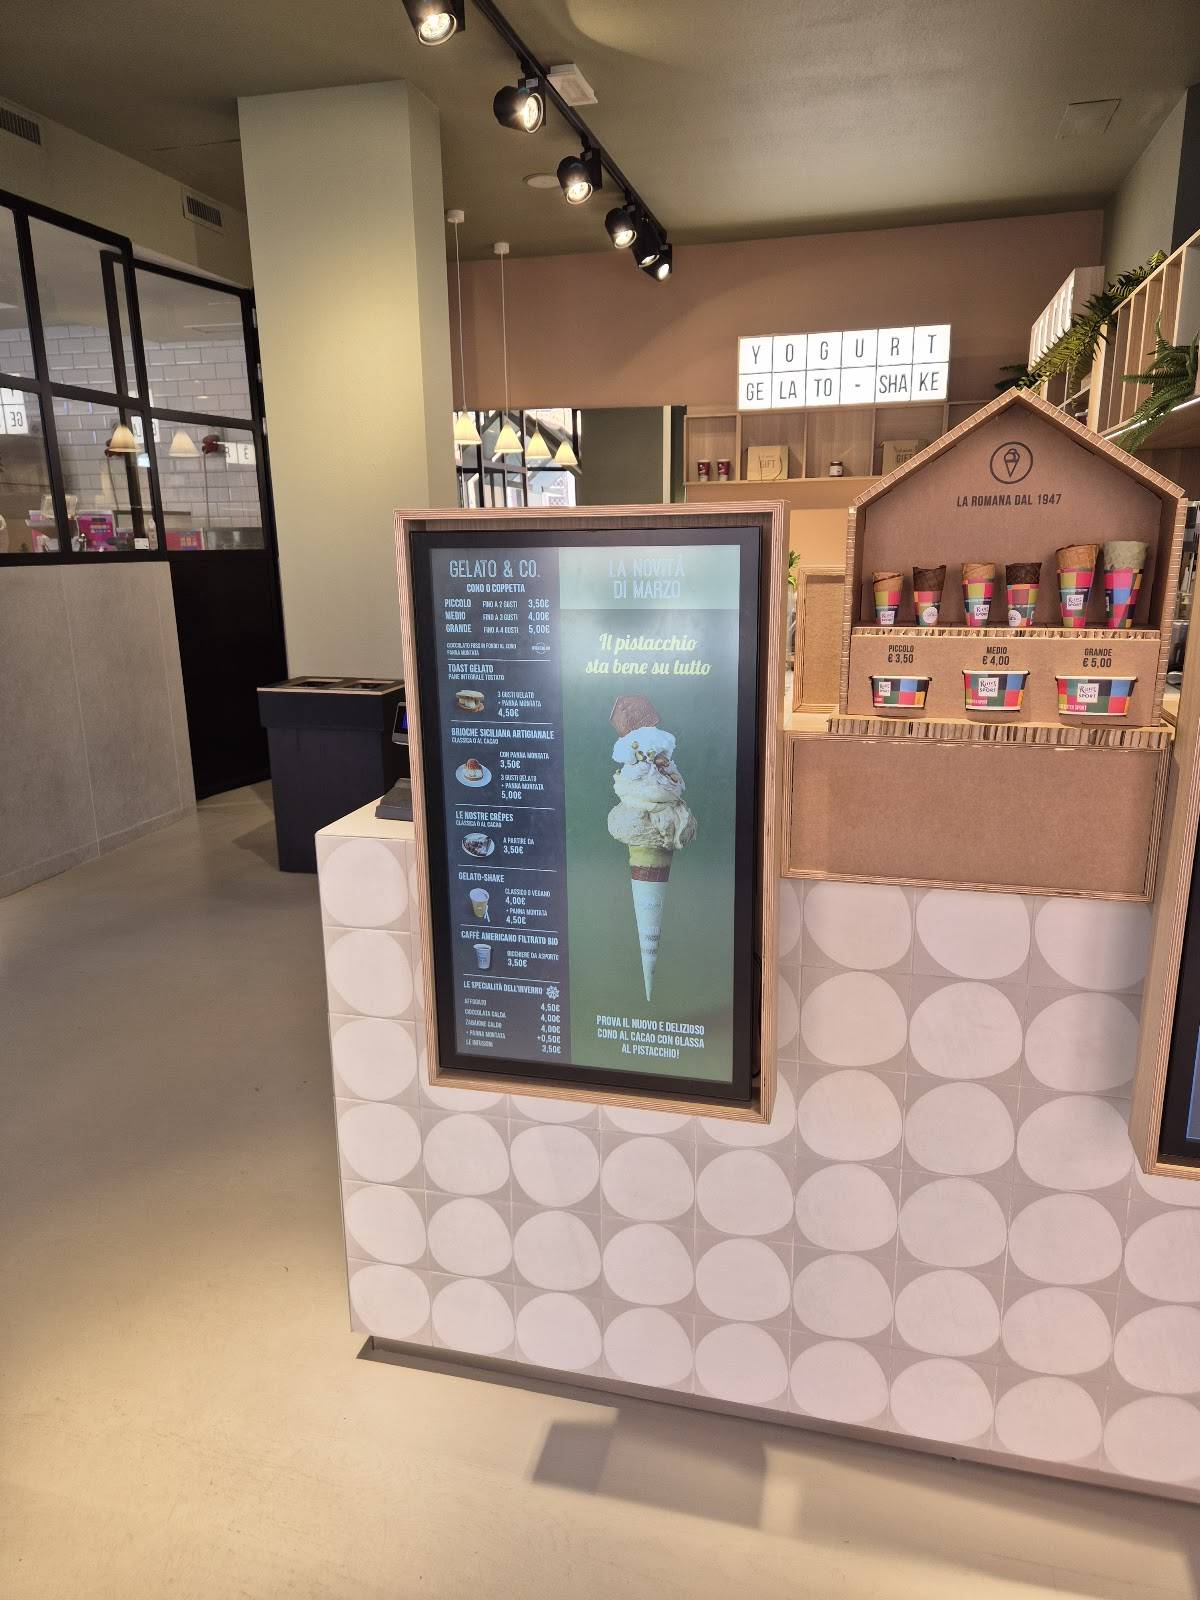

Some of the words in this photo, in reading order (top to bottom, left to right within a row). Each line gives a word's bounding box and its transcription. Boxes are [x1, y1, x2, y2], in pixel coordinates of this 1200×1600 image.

[752, 334, 937, 365] YOGURT
[746, 378, 833, 401] GELATO
[878, 371, 940, 394] SHAKE
[957, 496, 968, 507] LA
[971, 495, 1011, 506] ROMANA
[1015, 495, 1032, 505] DAL
[1038, 494, 1062, 505] 1947
[449, 560, 496, 578] GELATO
[503, 560, 513, 578] &
[520, 560, 540, 578] CO.
[608, 560, 626, 577] LA
[633, 554, 685, 577] NOVITÀ
[467, 584, 484, 592] CONO
[486, 584, 490, 592] O
[492, 584, 525, 592] COPPETTA
[614, 580, 626, 598] DI
[633, 580, 681, 598] MARZO
[444, 599, 472, 608] PICCOLO
[528, 599, 549, 608] 3,50€
[445, 611, 465, 620] MEDIO
[528, 612, 549, 620] 4,00€
[446, 624, 472, 632] GRANDE
[528, 625, 550, 634] 5,00€
[599, 633, 612, 650] Il
[614, 634, 698, 655] pistacchio
[888, 644, 914, 653] PICCOLO
[986, 646, 1007, 654] MEDIO
[1084, 648, 1112, 657] GRANDE
[888, 654, 893, 662] €
[895, 654, 914, 664] 3,50
[982, 656, 988, 665] €
[990, 656, 1009, 666] 4,00
[1083, 658, 1088, 667] €
[1091, 658, 1112, 668] 5,00
[448, 664, 468, 672] TOAST
[470, 664, 493, 673] GELATO
[586, 659, 609, 674] sta
[613, 659, 648, 674] bene
[651, 664, 670, 674] su
[673, 659, 712, 675] tutto
[498, 709, 519, 717] 4,50€
[452, 728, 478, 737] BRIOCHE
[480, 728, 510, 738] SICILIANA
[512, 730, 554, 739] ARTIGIANALE
[500, 760, 520, 768] 3,50€
[501, 791, 522, 799] 5,00€
[456, 811, 464, 819] LE
[464, 812, 488, 820] NOSTRE
[504, 846, 524, 854] 3,50€
[458, 872, 504, 882] GELATO-SHAKE
[506, 897, 526, 905] 4,00€
[506, 916, 526, 924] 4,50€
[461, 930, 480, 939] CAFFÈ
[482, 932, 516, 942] AMERICANO
[518, 934, 546, 944] FILTRATO
[548, 938, 558, 946] BIO
[508, 959, 527, 967] 3,50€
[472, 982, 502, 991] SPECIALITÀ
[504, 984, 542, 994] DELL'INVERNO
[540, 1003, 560, 1012] 4,50€
[540, 1014, 560, 1022] 4,00€
[541, 1025, 560, 1033] 4,00€
[597, 1015, 621, 1027] PROVA
[623, 1018, 630, 1027] IL
[632, 1018, 657, 1030] NUOVO
[659, 1021, 664, 1030] E
[665, 1022, 705, 1035] DELIZIOSO
[597, 1029, 618, 1039] CONO
[620, 1032, 629, 1040] AL
[631, 1033, 656, 1043] CACAO
[658, 1035, 673, 1044] CON
[675, 1037, 705, 1048] GLASSA
[622, 1044, 632, 1054] AL
[633, 1045, 680, 1059] PISTACCHIO!
